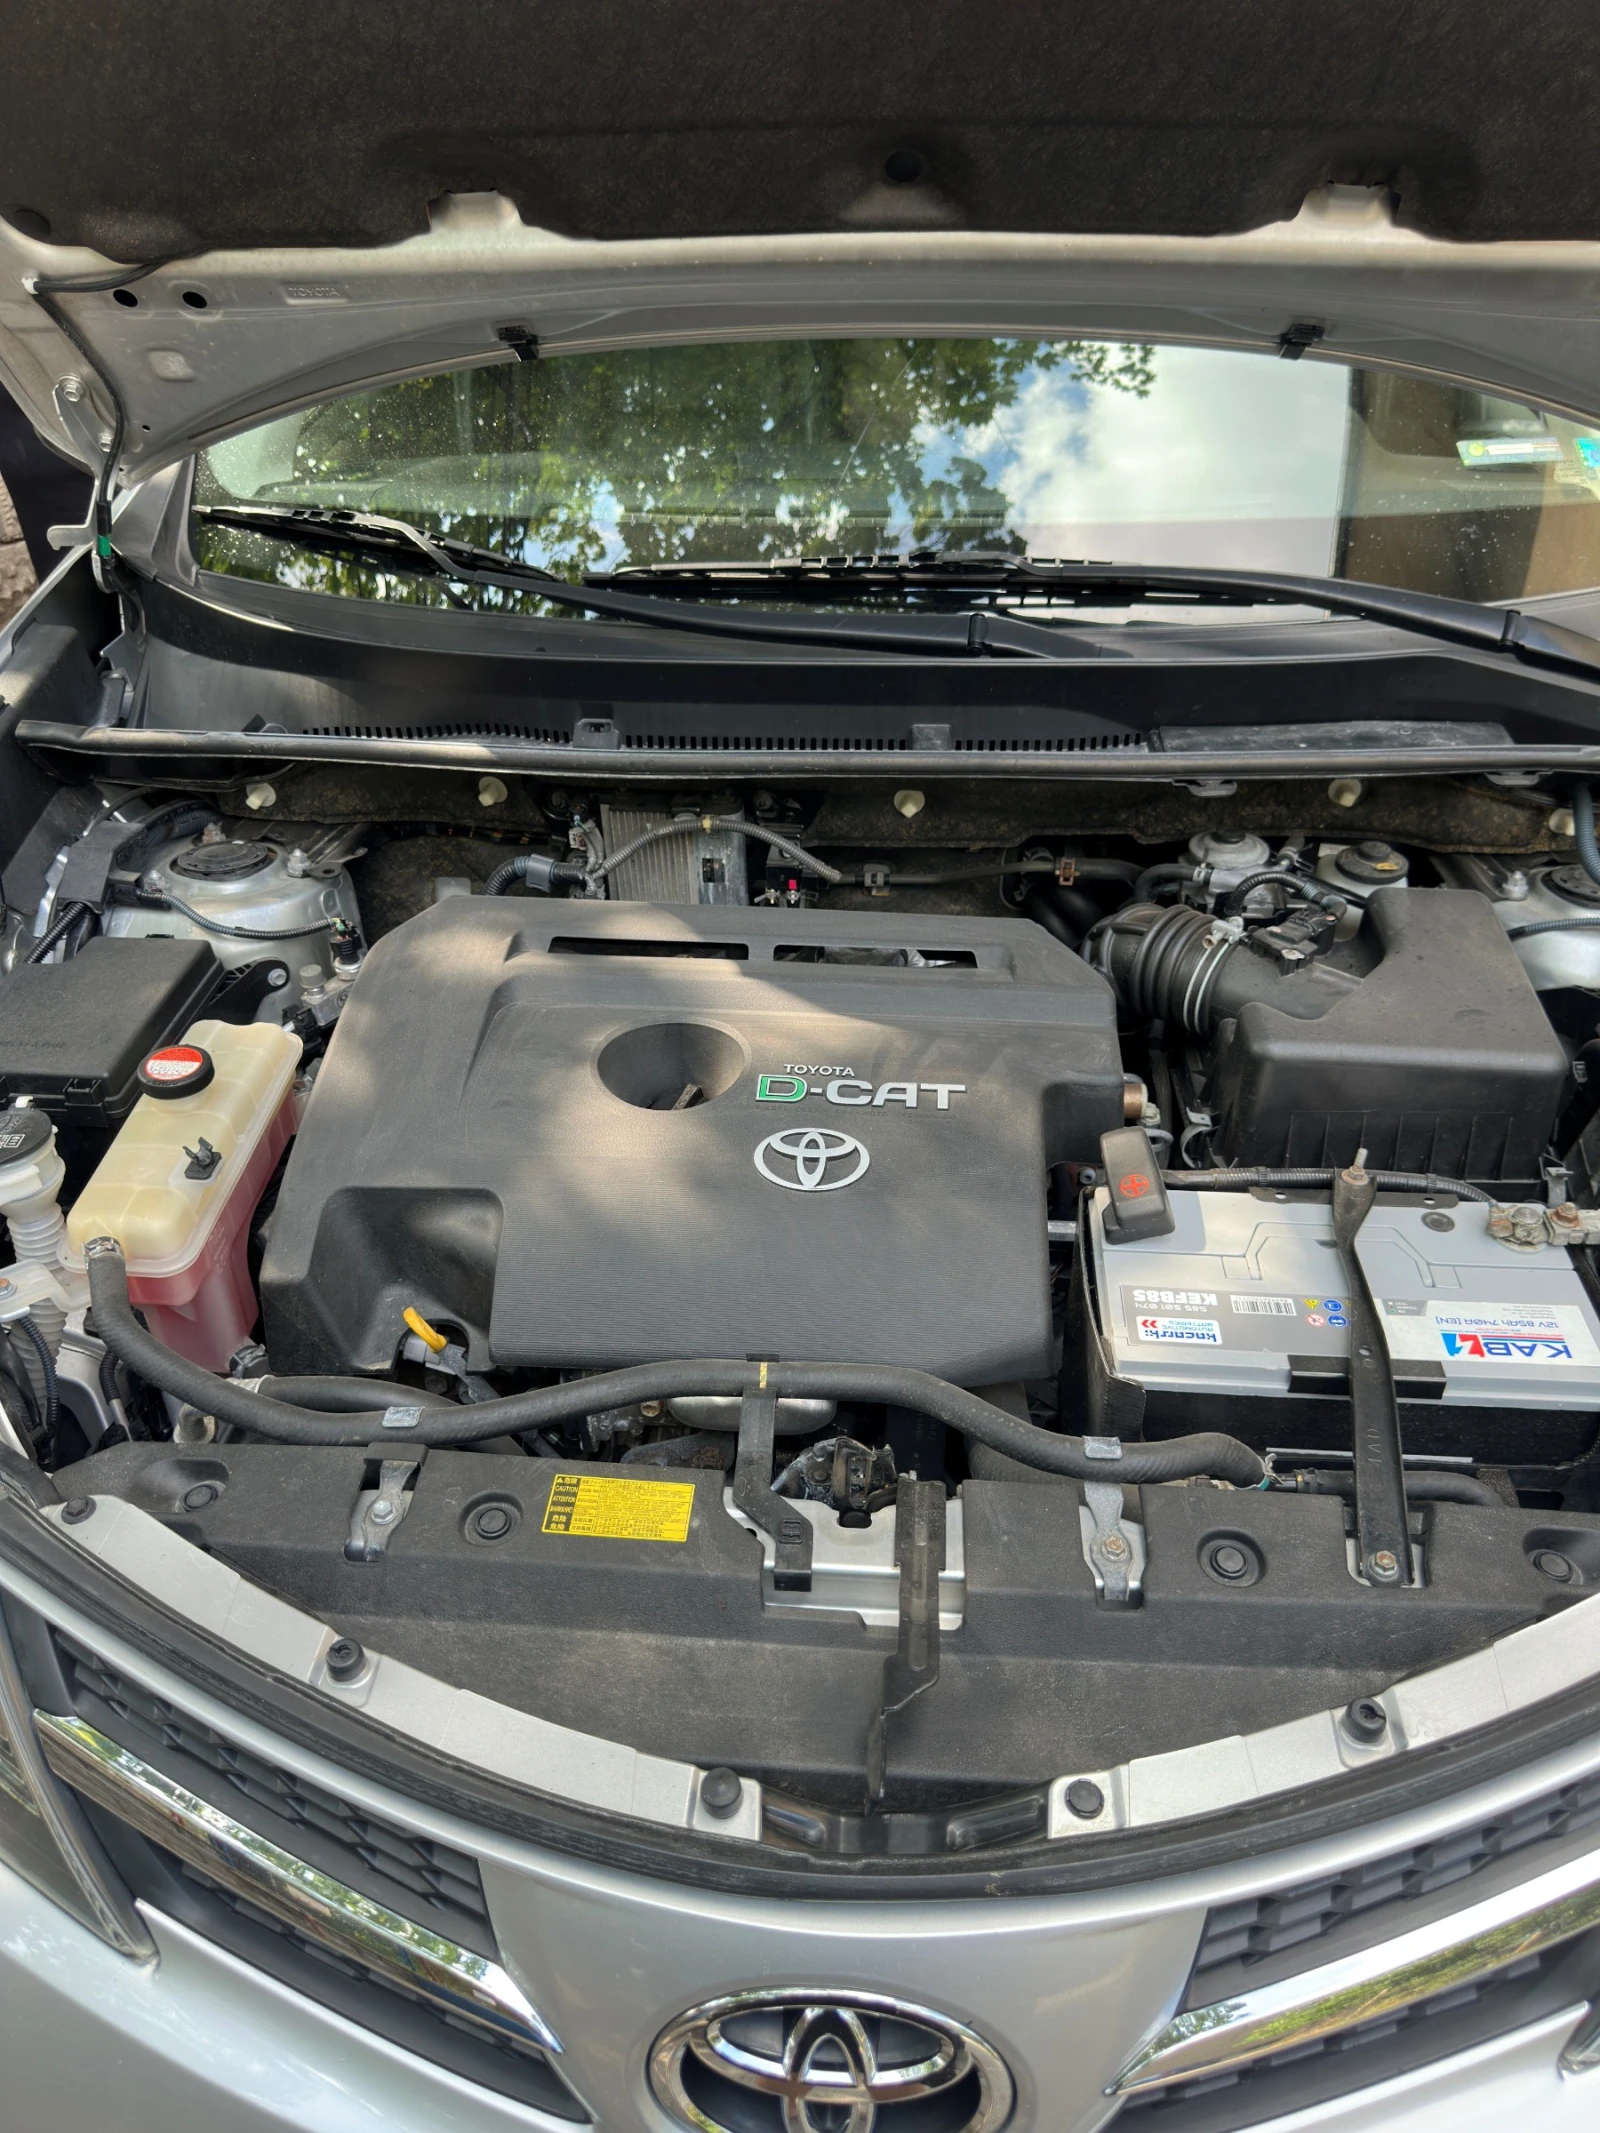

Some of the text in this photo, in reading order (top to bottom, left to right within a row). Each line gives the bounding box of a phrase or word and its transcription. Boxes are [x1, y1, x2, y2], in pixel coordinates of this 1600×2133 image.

[288, 287, 341, 297] TOYOTA
[784, 1064, 855, 1077] TOYOTA
[755, 1074, 967, 1111] D-CAT
[1132, 1289, 1218, 1306] KEFB85
[1464, 1317, 1499, 1326] 740A
[1501, 1318, 1535, 1327] 85Ah
[1538, 1319, 1559, 1328] 12V
[1162, 1324, 1214, 1332] AUTOMOTIVE
